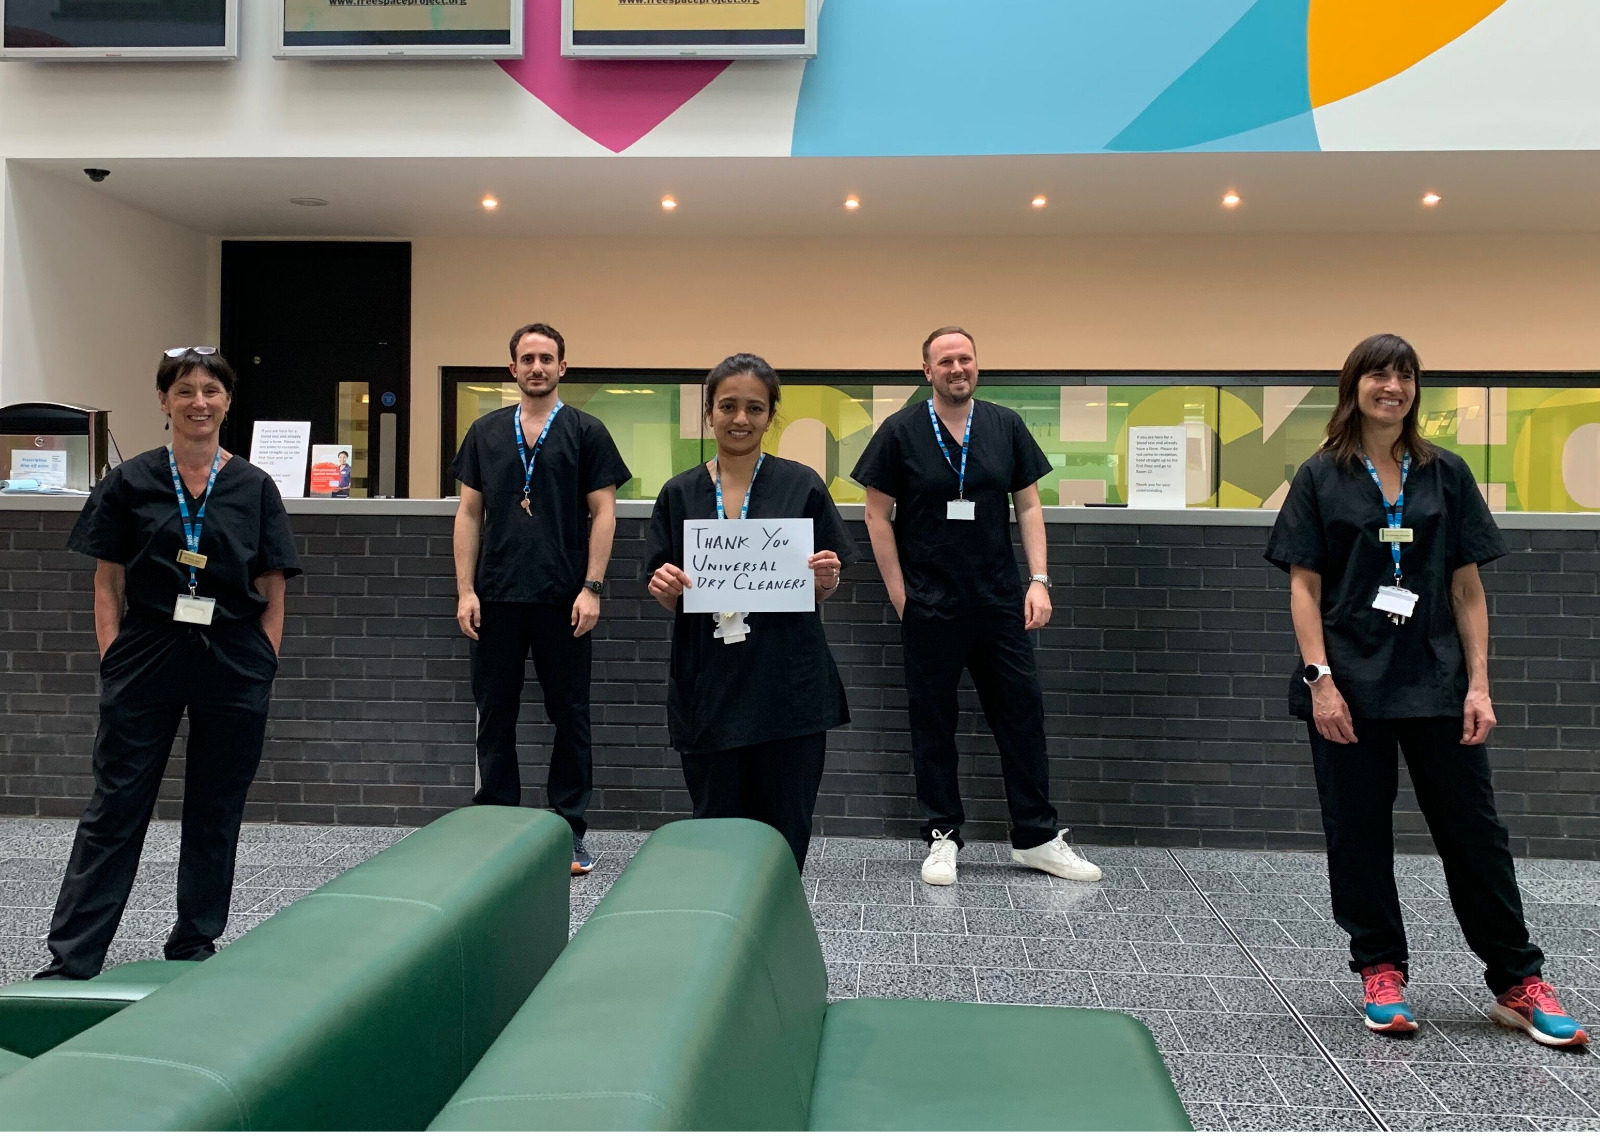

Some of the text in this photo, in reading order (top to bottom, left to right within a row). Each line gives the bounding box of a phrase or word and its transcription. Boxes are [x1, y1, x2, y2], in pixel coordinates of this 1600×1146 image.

[691, 527, 790, 550] THANK YOU
[692, 554, 777, 572] UNIVERSAL
[697, 572, 806, 590] DRY CLEANERS
